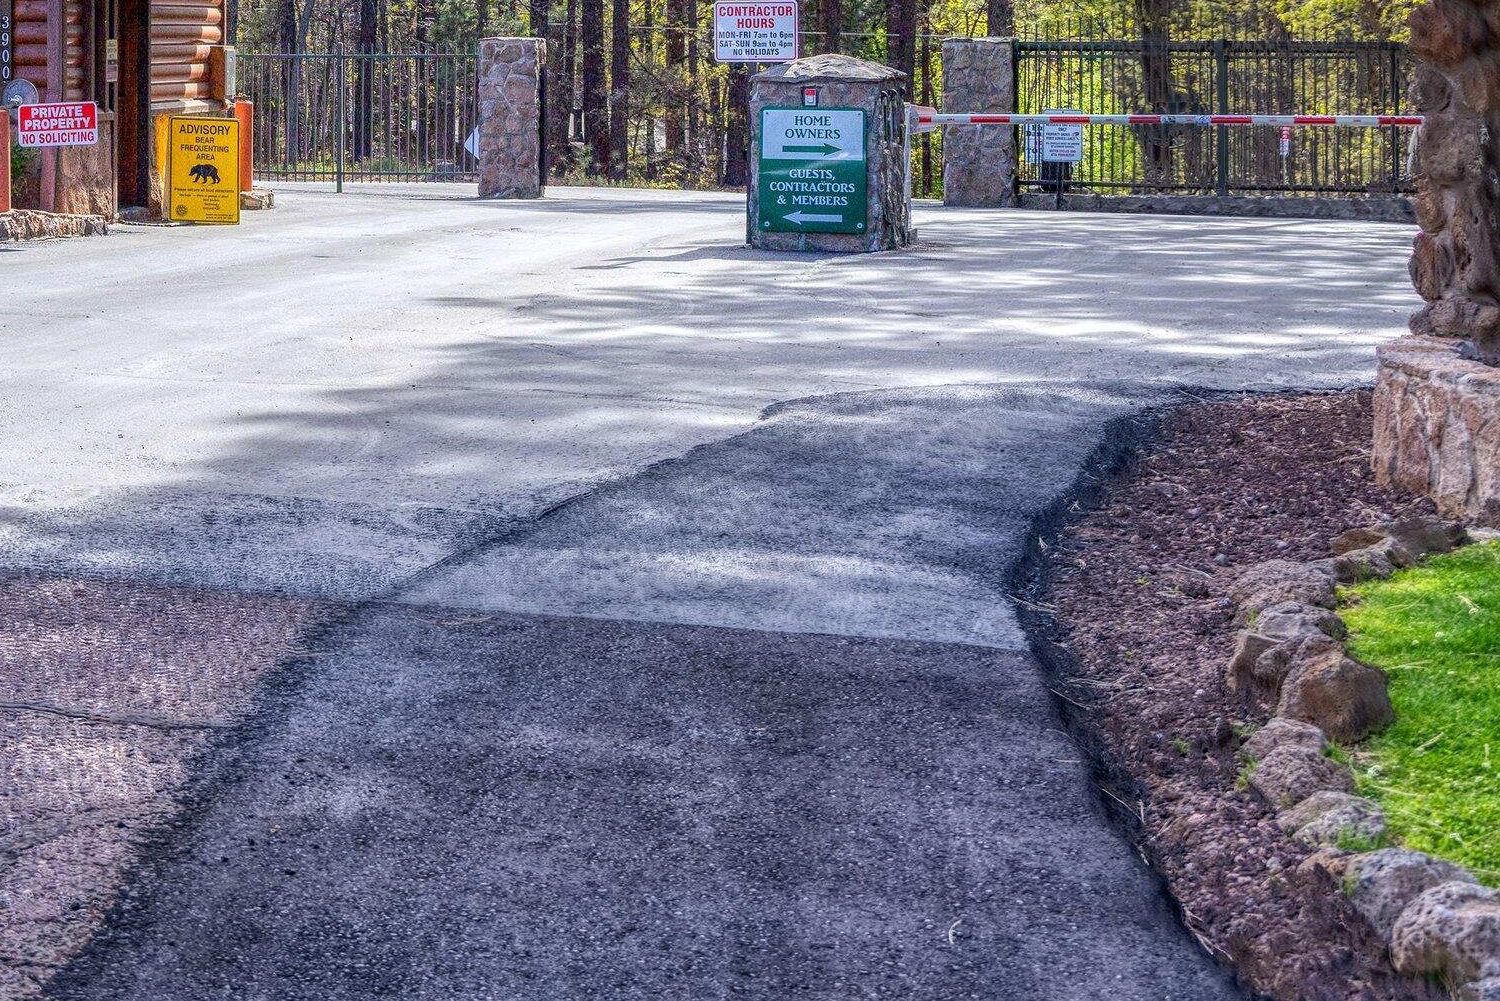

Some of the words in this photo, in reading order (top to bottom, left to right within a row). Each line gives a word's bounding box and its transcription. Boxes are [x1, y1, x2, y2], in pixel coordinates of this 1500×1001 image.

[719, 6, 793, 16] CONTRACTOR
[737, 18, 775, 28] HOURS
[718, 31, 751, 39] MON-FRI
[753, 31, 768, 39] 7am
[770, 31, 777, 39] to
[779, 31, 794, 40] 6pm
[1, 15, 10, 79] 3900
[719, 40, 750, 48] SAT-SUN
[752, 40, 767, 48] 9am
[769, 40, 777, 48] to
[778, 40, 793, 49] 4pm
[733, 48, 743, 56] NO
[745, 48, 780, 56] HOLIDAYS
[31, 105, 83, 118] PRIVATE
[24, 117, 91, 131] PROPERTY
[794, 115, 832, 126] HOME
[179, 124, 231, 135] ADVISORY
[785, 128, 841, 139] OWNERS
[22, 133, 36, 144] NO
[39, 131, 95, 144] SOLICITING
[195, 136, 215, 144] BEAR
[180, 144, 230, 153] FREQUENTING
[196, 153, 216, 161] AREA
[788, 168, 836, 181] GUESTS,
[769, 181, 856, 193] CONTRACTORS
[776, 194, 787, 205] &
[792, 195, 848, 206] MEMBERS
